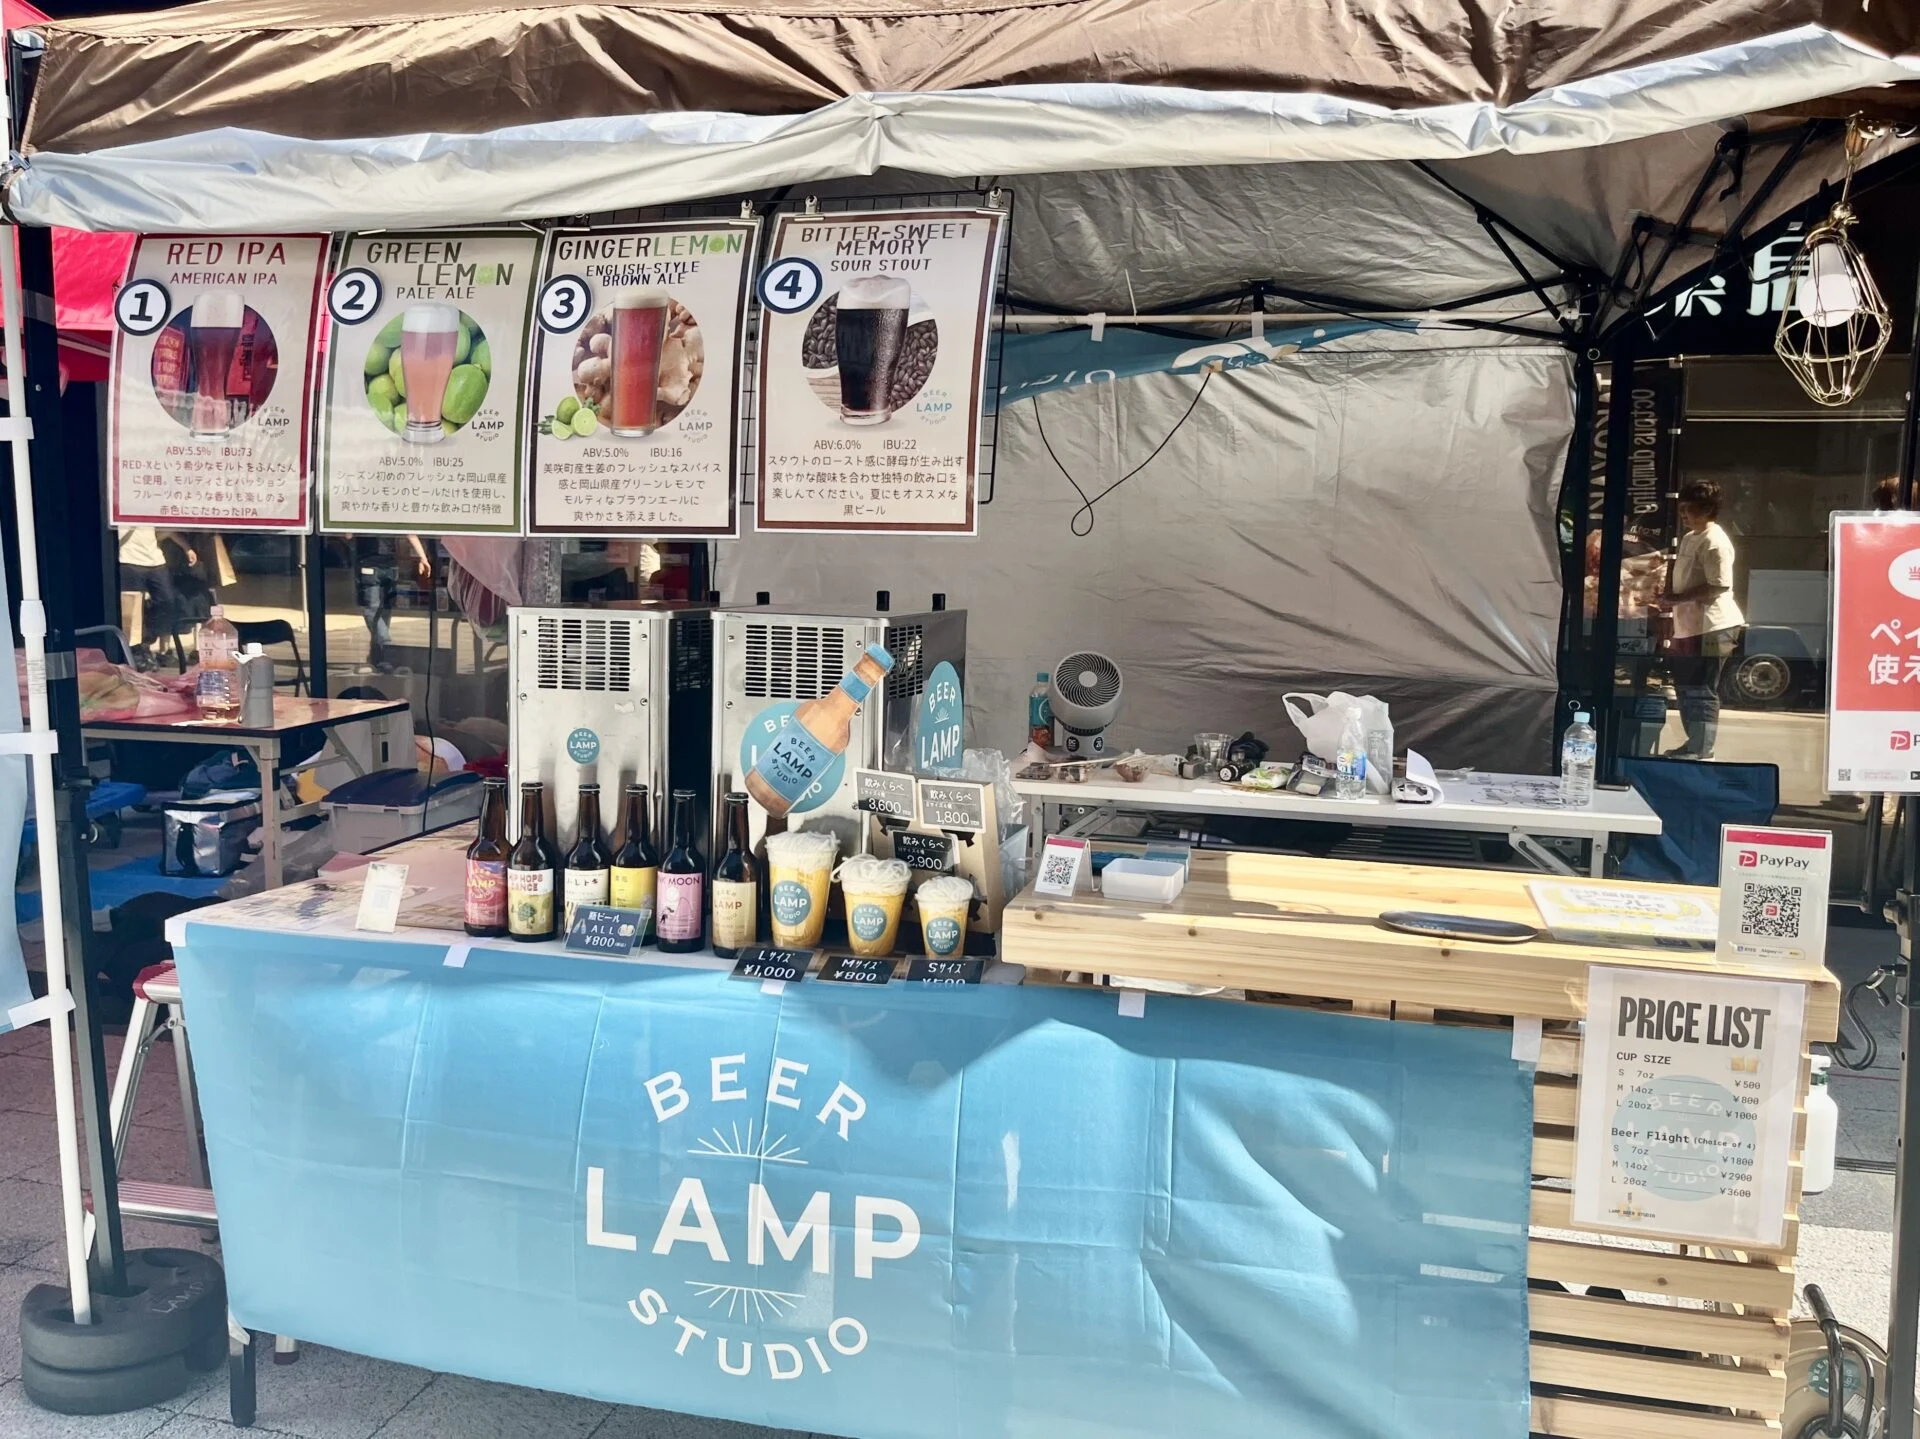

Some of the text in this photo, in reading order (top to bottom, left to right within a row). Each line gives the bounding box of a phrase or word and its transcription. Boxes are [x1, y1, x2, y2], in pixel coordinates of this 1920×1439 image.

[801, 223, 972, 243] BITTER-SWEET
[166, 242, 286, 265] RED IPA
[366, 242, 462, 264] GREEN
[836, 239, 930, 256] MEMORY
[586, 261, 700, 277] ENGLISH-STYLE
[830, 258, 932, 272] SOUR STOUT
[170, 272, 278, 285] AMERICAN IPA
[602, 273, 686, 287] BROWN ALE
[774, 269, 802, 300] 4
[342, 279, 366, 310] 2
[397, 287, 476, 299] PALE ALE
[129, 291, 153, 322] 1
[551, 287, 575, 319] 3
[916, 402, 953, 413] LAMP
[258, 417, 290, 426] LAMP
[471, 421, 505, 430] LAMP
[679, 421, 713, 432] LAMP
[221, 447, 252, 457] IBU:73
[814, 439, 917, 450] ABV:6.0% IBU:22
[582, 448, 682, 458] ABV:5.0% IBU:16
[379, 457, 464, 467] ABV:5.0% IBU:25
[768, 455, 965, 467] スタウトのロースト感に酵母が生み出す
[558, 479, 706, 490] 感と岡山県産グリーンレモンで
[772, 472, 958, 484] 爽やかな酸味を合わせ独特の飲み口を
[564, 495, 700, 506] モルティなブラウンエールに
[573, 510, 684, 522] 爽やかさを添えました。
[843, 505, 886, 516] 黒ビール
[929, 681, 956, 714] BEER
[570, 741, 597, 749] LAMP
[791, 737, 815, 762] BEER
[922, 724, 960, 768] LAMP
[773, 742, 813, 779] LAMP
[772, 758, 798, 784] STUDIO
[930, 789, 972, 801] 飲みくらべ
[868, 798, 902, 813] 3,600
[936, 810, 969, 825] 1,800
[907, 854, 942, 870] 2,900
[1760, 854, 1810, 870] PayPay
[668, 877, 700, 886] MOON
[778, 885, 801, 894] BEER
[773, 895, 808, 908] LAMP
[854, 915, 884, 926] LAMP
[585, 935, 615, 947] ¥800
[928, 928, 958, 940] LAMP
[743, 964, 796, 979] ¥1,000
[833, 970, 877, 982] ¥800
[1617, 996, 1771, 1050] PRICE LIST
[1616, 1052, 1672, 1065] CUP SIZE
[1636, 1070, 1654, 1079] 7oz
[1734, 1079, 1761, 1090] ¥500
[643, 1052, 867, 1141] BEER
[1617, 1084, 1760, 1105] M 14oz ¥800
[1628, 1100, 1652, 1110] 20oz
[1725, 1110, 1758, 1121] ¥1000
[1611, 1127, 1640, 1138] Beer
[1647, 1131, 1690, 1144] Flight
[1694, 1137, 1727, 1147] (Choice
[1731, 1139, 1742, 1148] of
[1613, 1144, 1754, 1166] S 7oz ¥1800
[1612, 1160, 1753, 1182] M 14oz ¥2900
[1612, 1176, 1752, 1198] L 20oz ¥3600
[586, 1166, 921, 1279] LAMP
[628, 1288, 868, 1380] STUDIO
